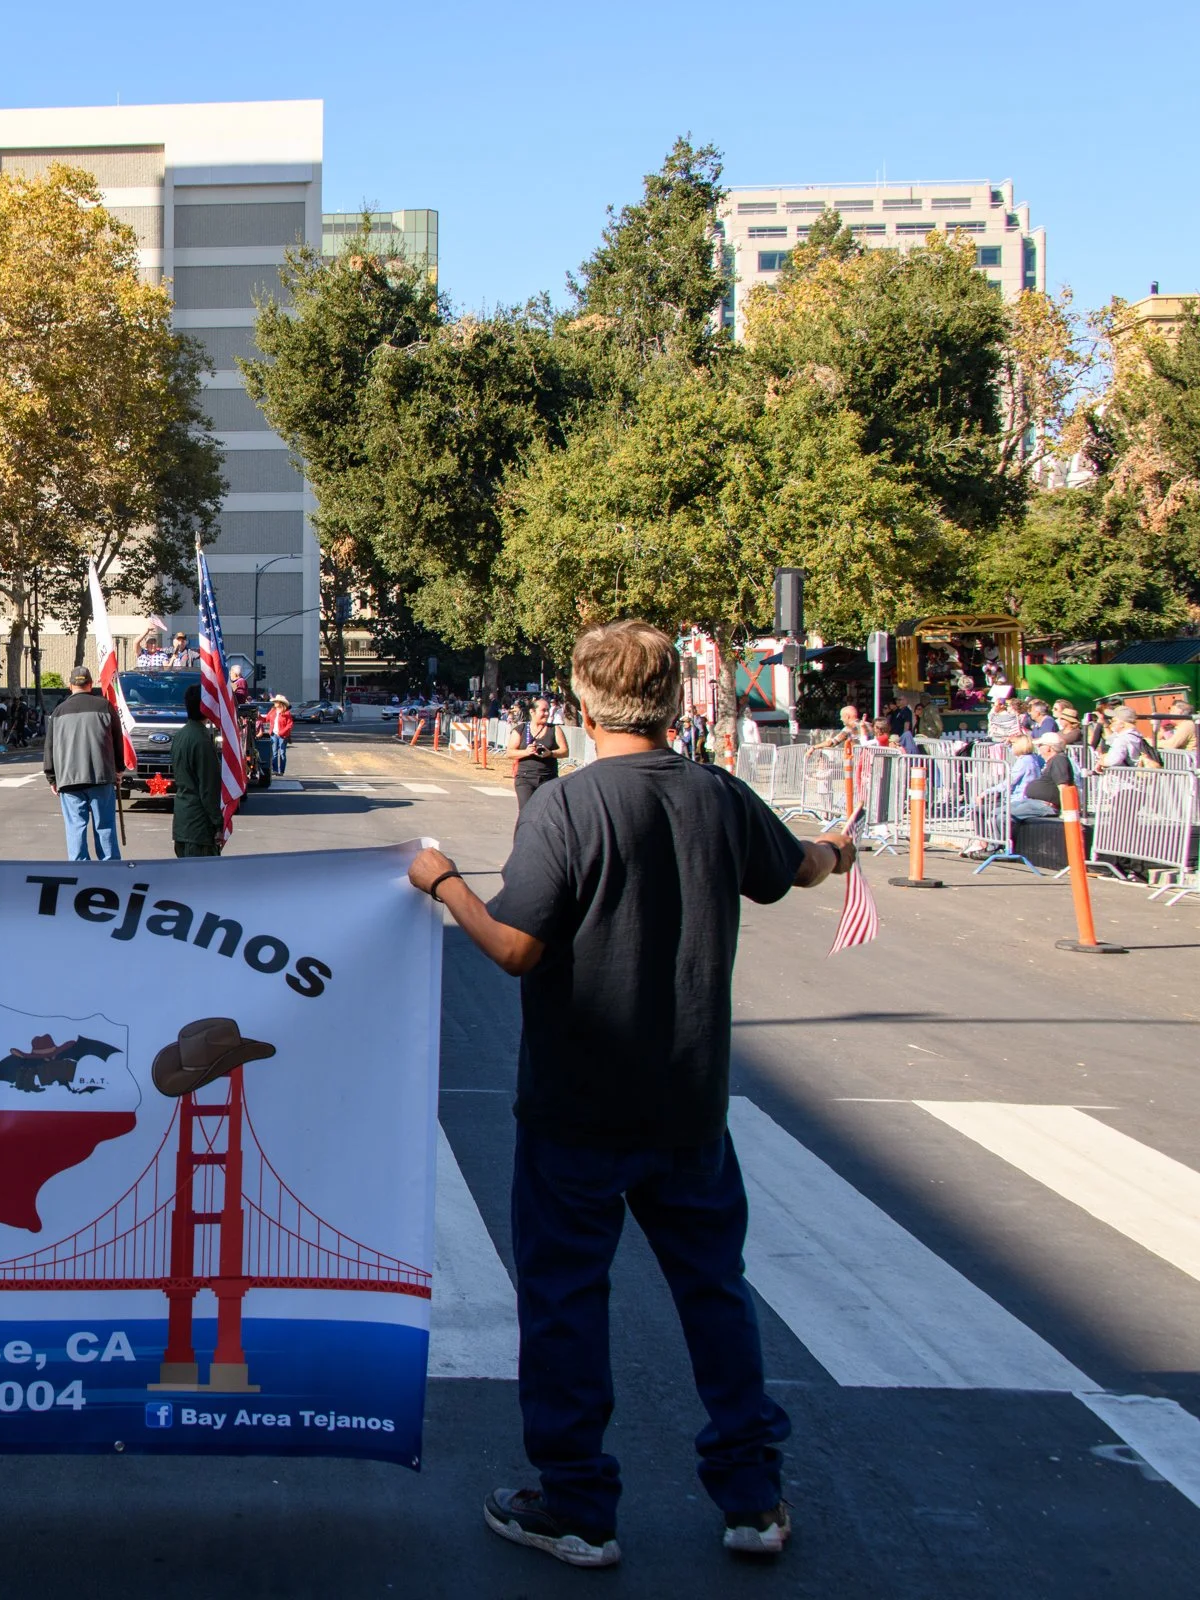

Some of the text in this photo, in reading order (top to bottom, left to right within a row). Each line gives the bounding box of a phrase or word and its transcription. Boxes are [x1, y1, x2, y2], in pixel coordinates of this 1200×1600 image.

[26, 875, 333, 998] Tejanos
[65, 1331, 136, 1363] CA
[181, 1408, 227, 1430] Bay
[234, 1409, 291, 1427] Area
[299, 1410, 395, 1432] Tejanos
